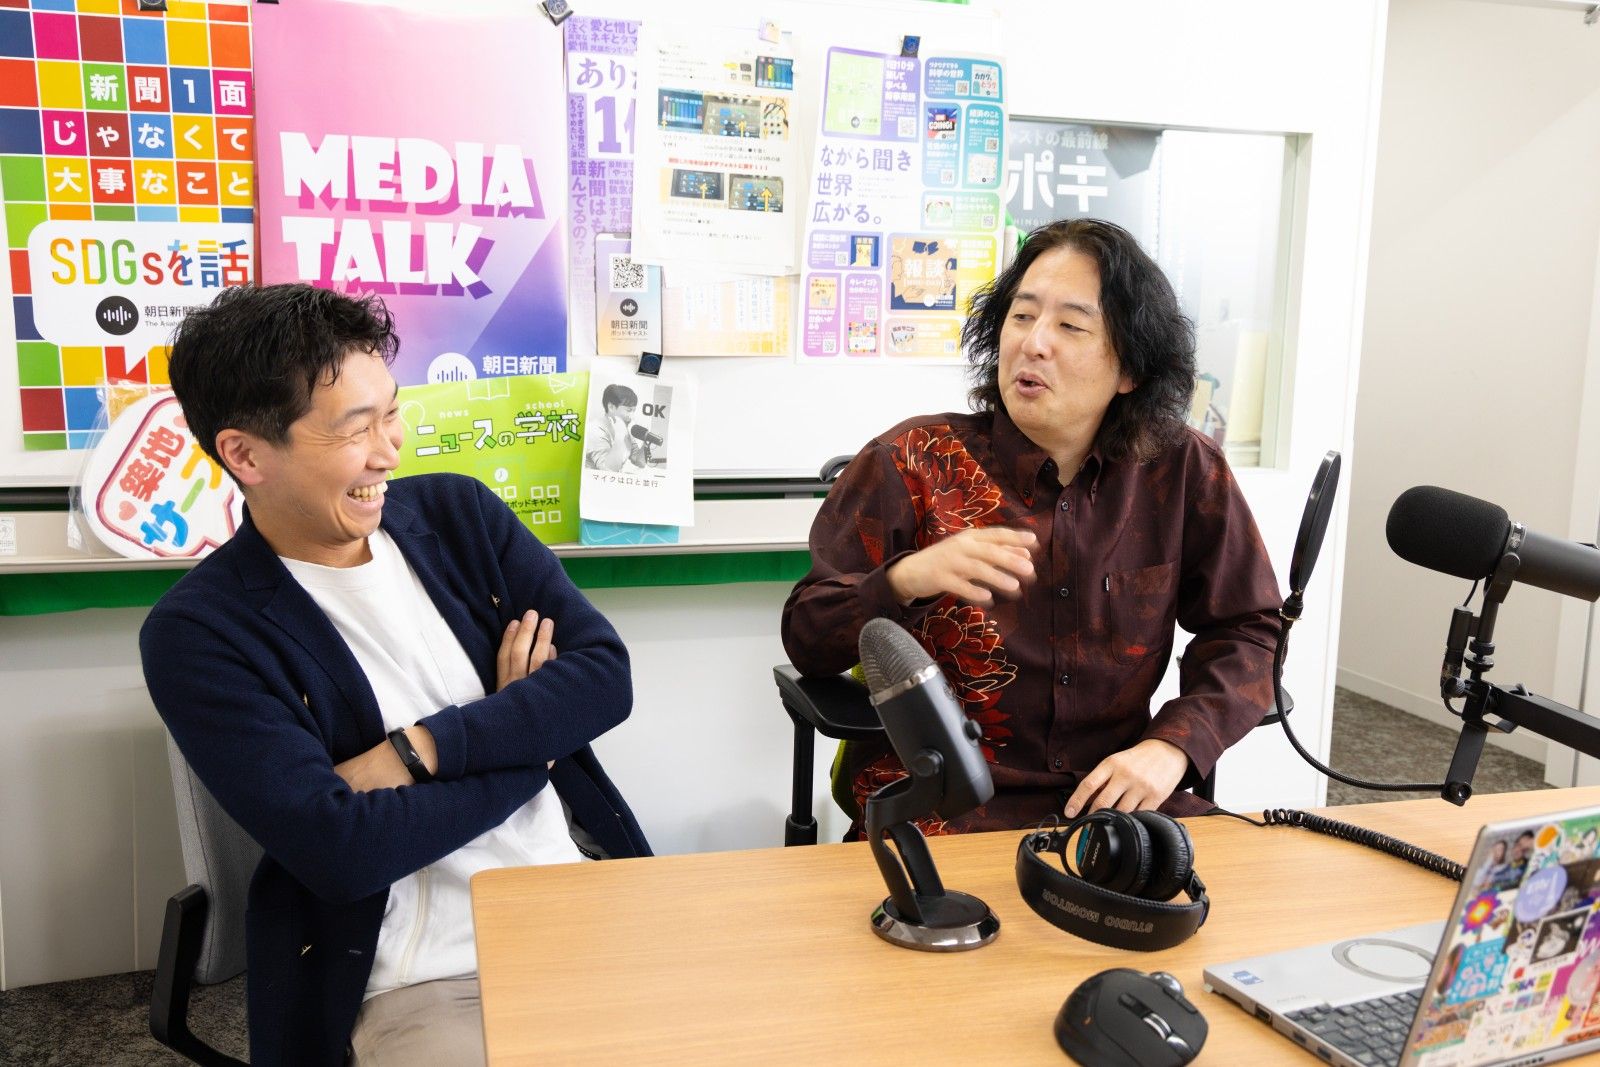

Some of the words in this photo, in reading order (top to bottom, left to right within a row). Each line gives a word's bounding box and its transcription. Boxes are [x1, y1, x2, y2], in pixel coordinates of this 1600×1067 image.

[577, 57, 637, 90] あり
[89, 74, 247, 107] 新聞1面
[53, 120, 248, 150] じゃなくて
[280, 131, 534, 208] MEDIA
[821, 144, 912, 171] ながら聞き
[53, 167, 250, 195] 大事なこと
[817, 172, 853, 196] 世界
[813, 200, 882, 224] 広がる。
[50, 238, 249, 288] SDGsを話
[281, 216, 483, 287] TALK
[611, 320, 648, 330] 朝日新聞
[482, 355, 557, 375] 朝日新聞
[439, 410, 470, 420] news
[526, 400, 565, 411] school
[642, 403, 666, 419] OK
[416, 409, 582, 457] ニュースの学校
[119, 426, 186, 502] 築地
[592, 473, 659, 488] マイクは口と並行
[1091, 842, 1100, 867] SONY
[1042, 888, 1100, 923] MONITOR
[1104, 915, 1154, 934] STUDIO
